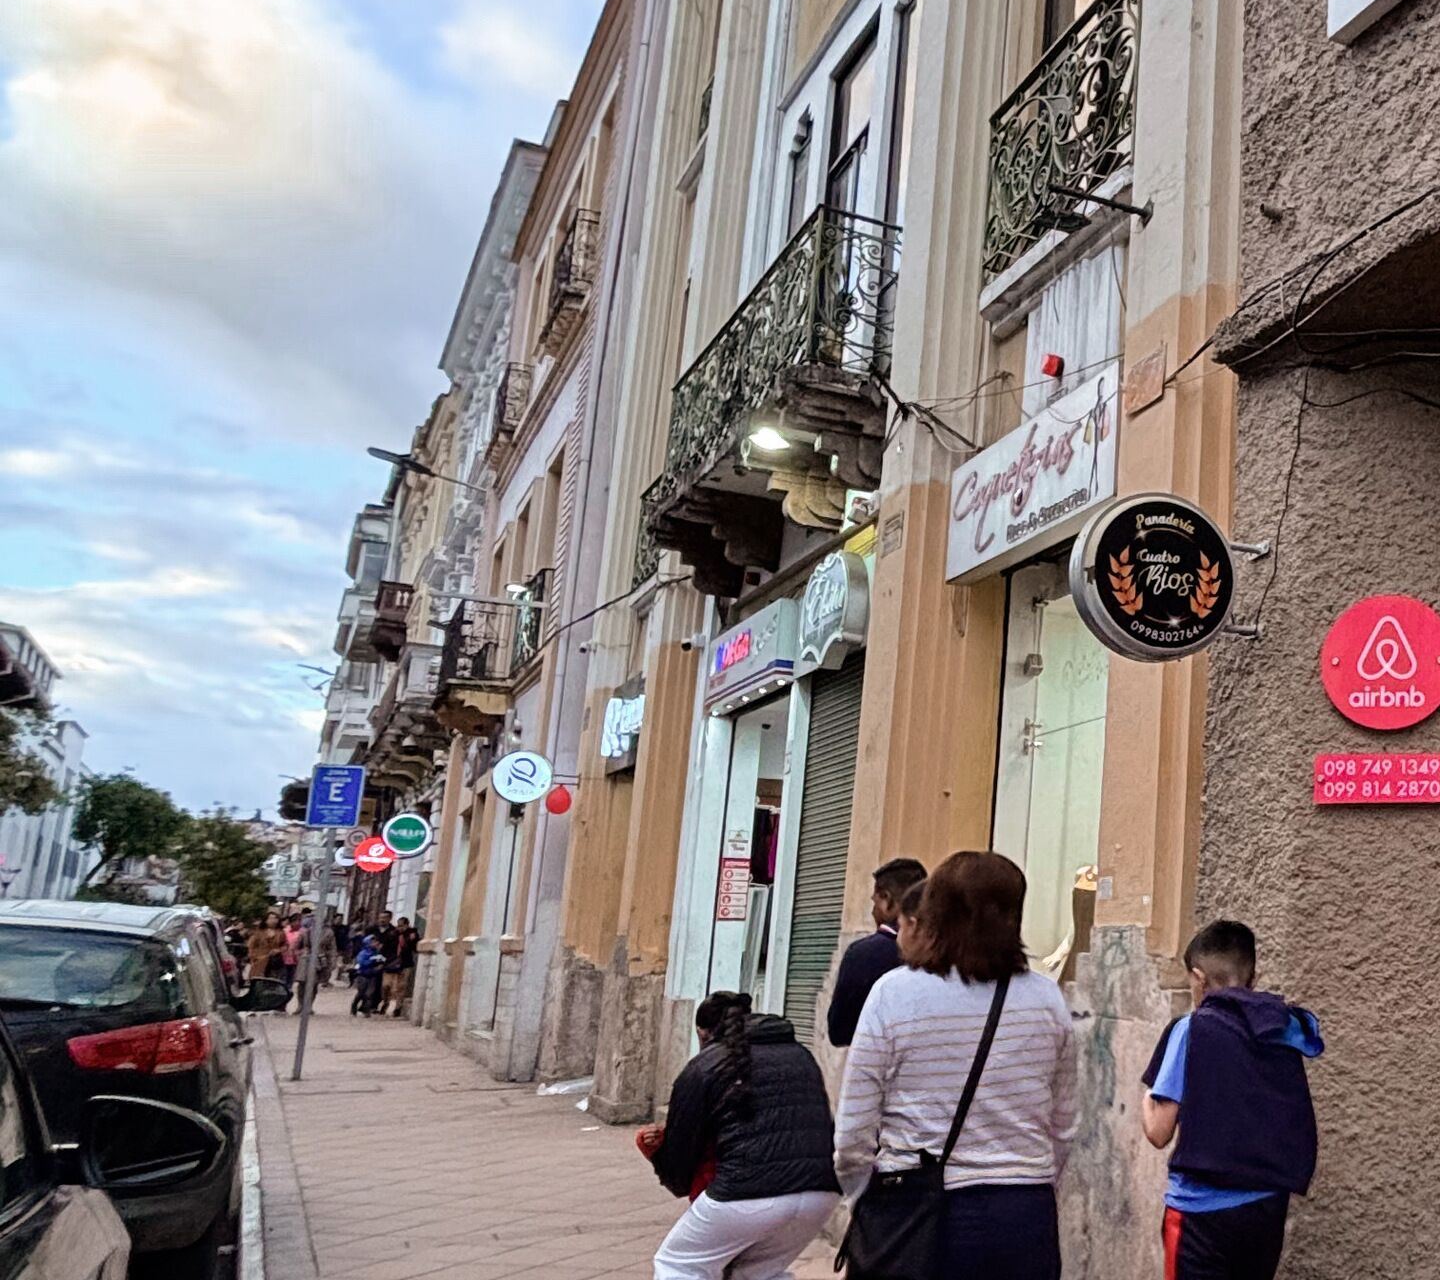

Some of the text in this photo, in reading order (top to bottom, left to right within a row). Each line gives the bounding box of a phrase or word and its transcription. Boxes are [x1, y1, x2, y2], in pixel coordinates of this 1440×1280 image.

[1136, 548, 1181, 564] Cuatro
[1138, 563, 1195, 597] Rios
[1130, 620, 1200, 642] 0998302764
[1348, 684, 1426, 708] airbnb
[1323, 758, 1440, 776] 098 749 1349
[329, 782, 345, 802] E
[1323, 780, 1440, 798] 099 814 2870
